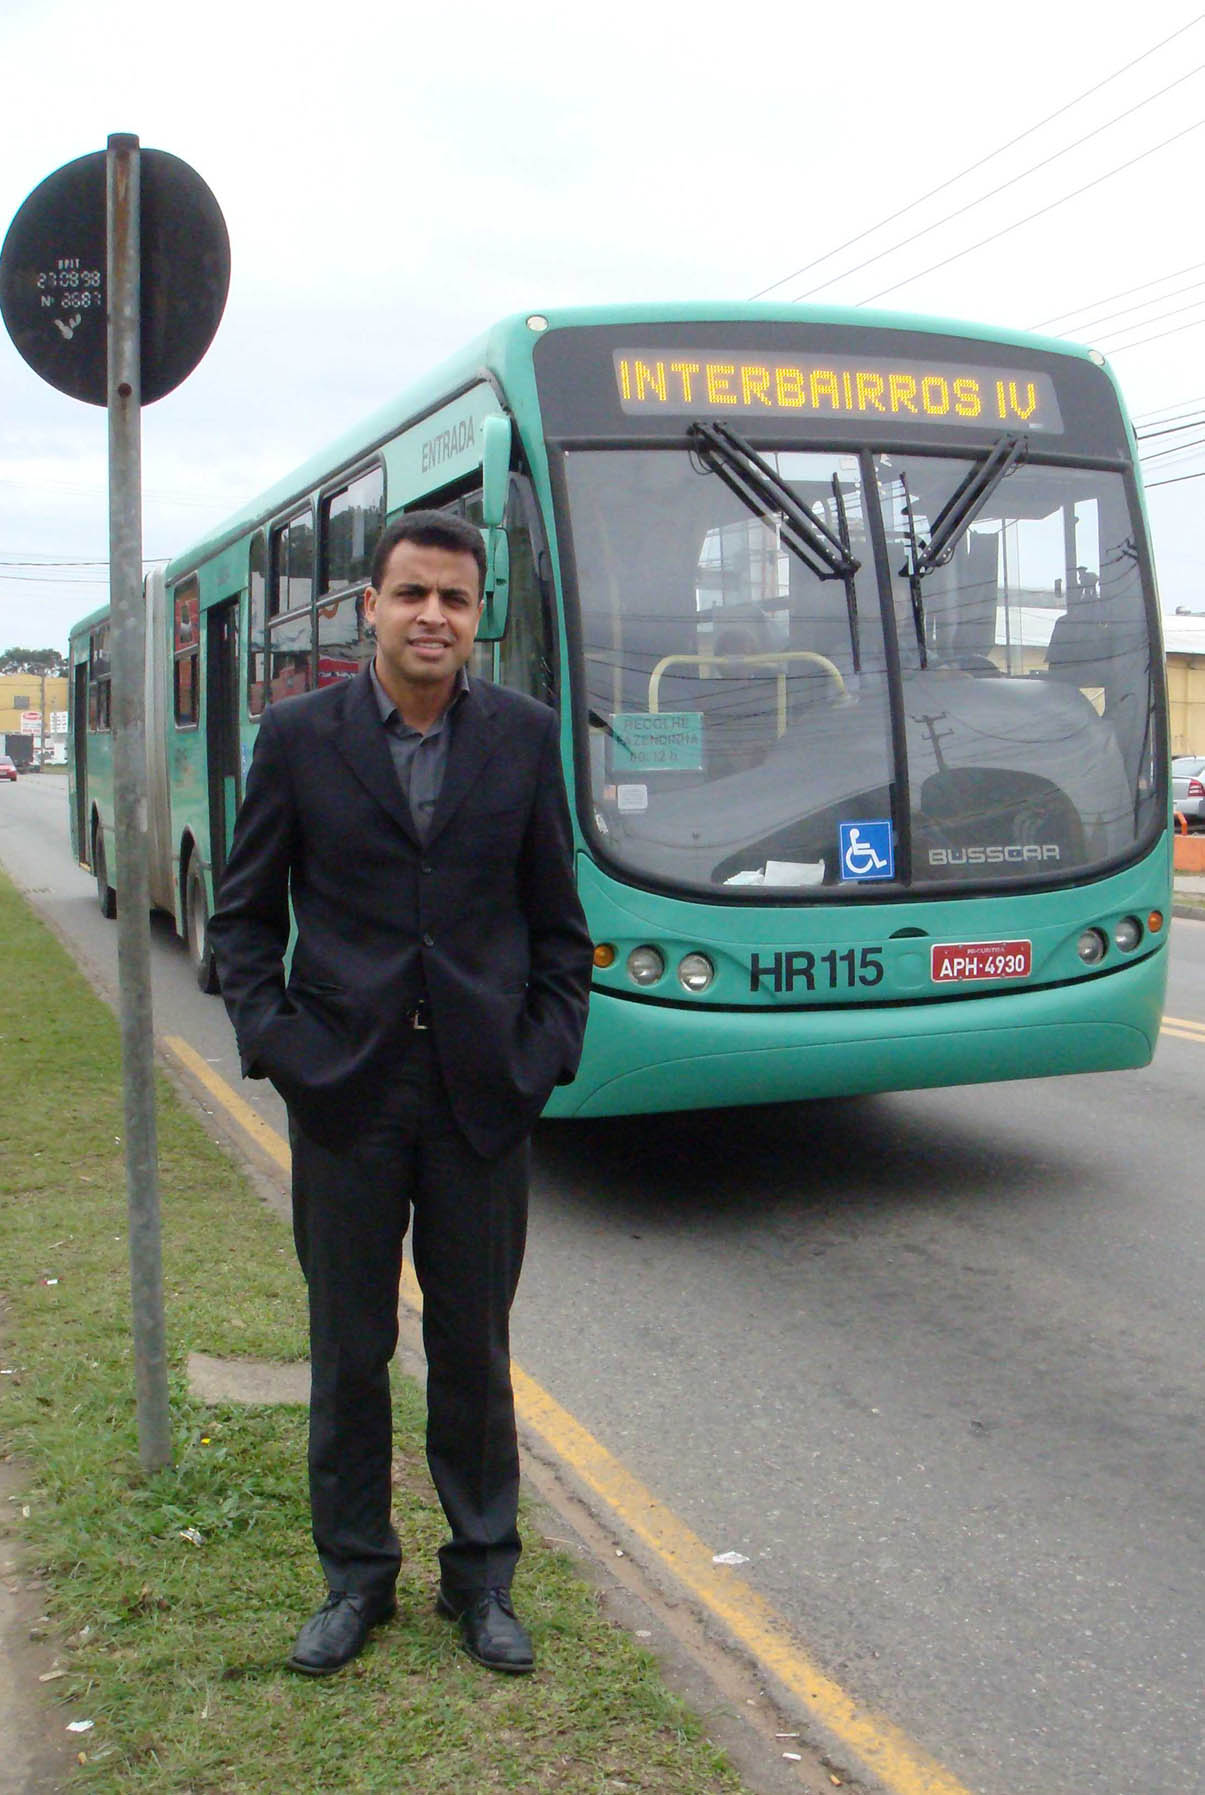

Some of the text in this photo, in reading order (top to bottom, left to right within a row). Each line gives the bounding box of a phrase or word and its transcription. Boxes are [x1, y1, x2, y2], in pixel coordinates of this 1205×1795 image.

[619, 361, 1037, 420] INTERBAIRROS IV
[421, 416, 475, 474] ENTRADA
[928, 845, 1060, 865] BUSSCAR
